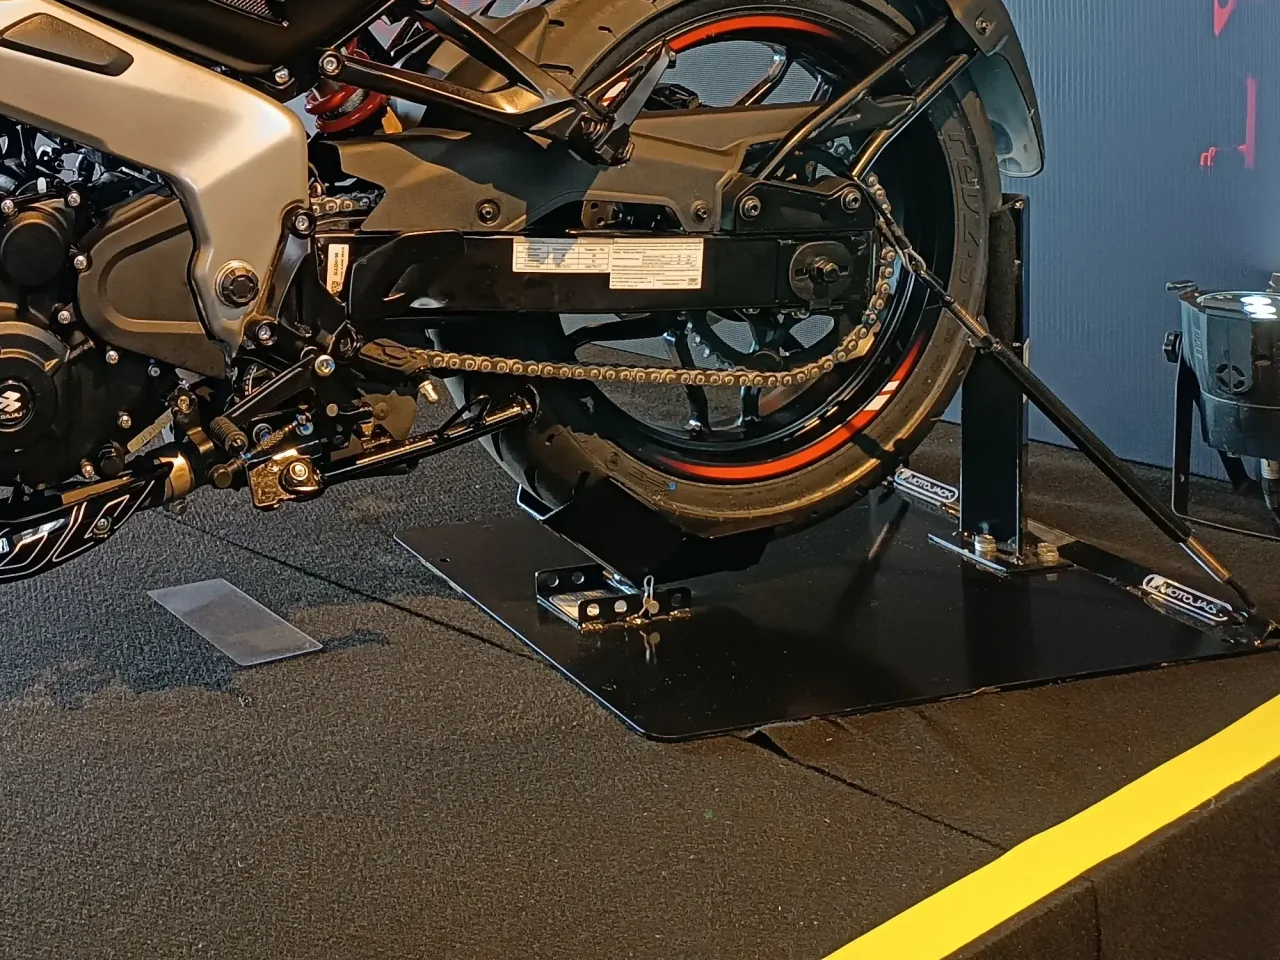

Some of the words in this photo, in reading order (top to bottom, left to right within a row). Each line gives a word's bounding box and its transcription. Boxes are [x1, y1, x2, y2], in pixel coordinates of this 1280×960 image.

[0, 410, 24, 420] BAJAJ
[907, 474, 955, 500] MOTOJACK
[1160, 582, 1223, 618] MOTOJAC
